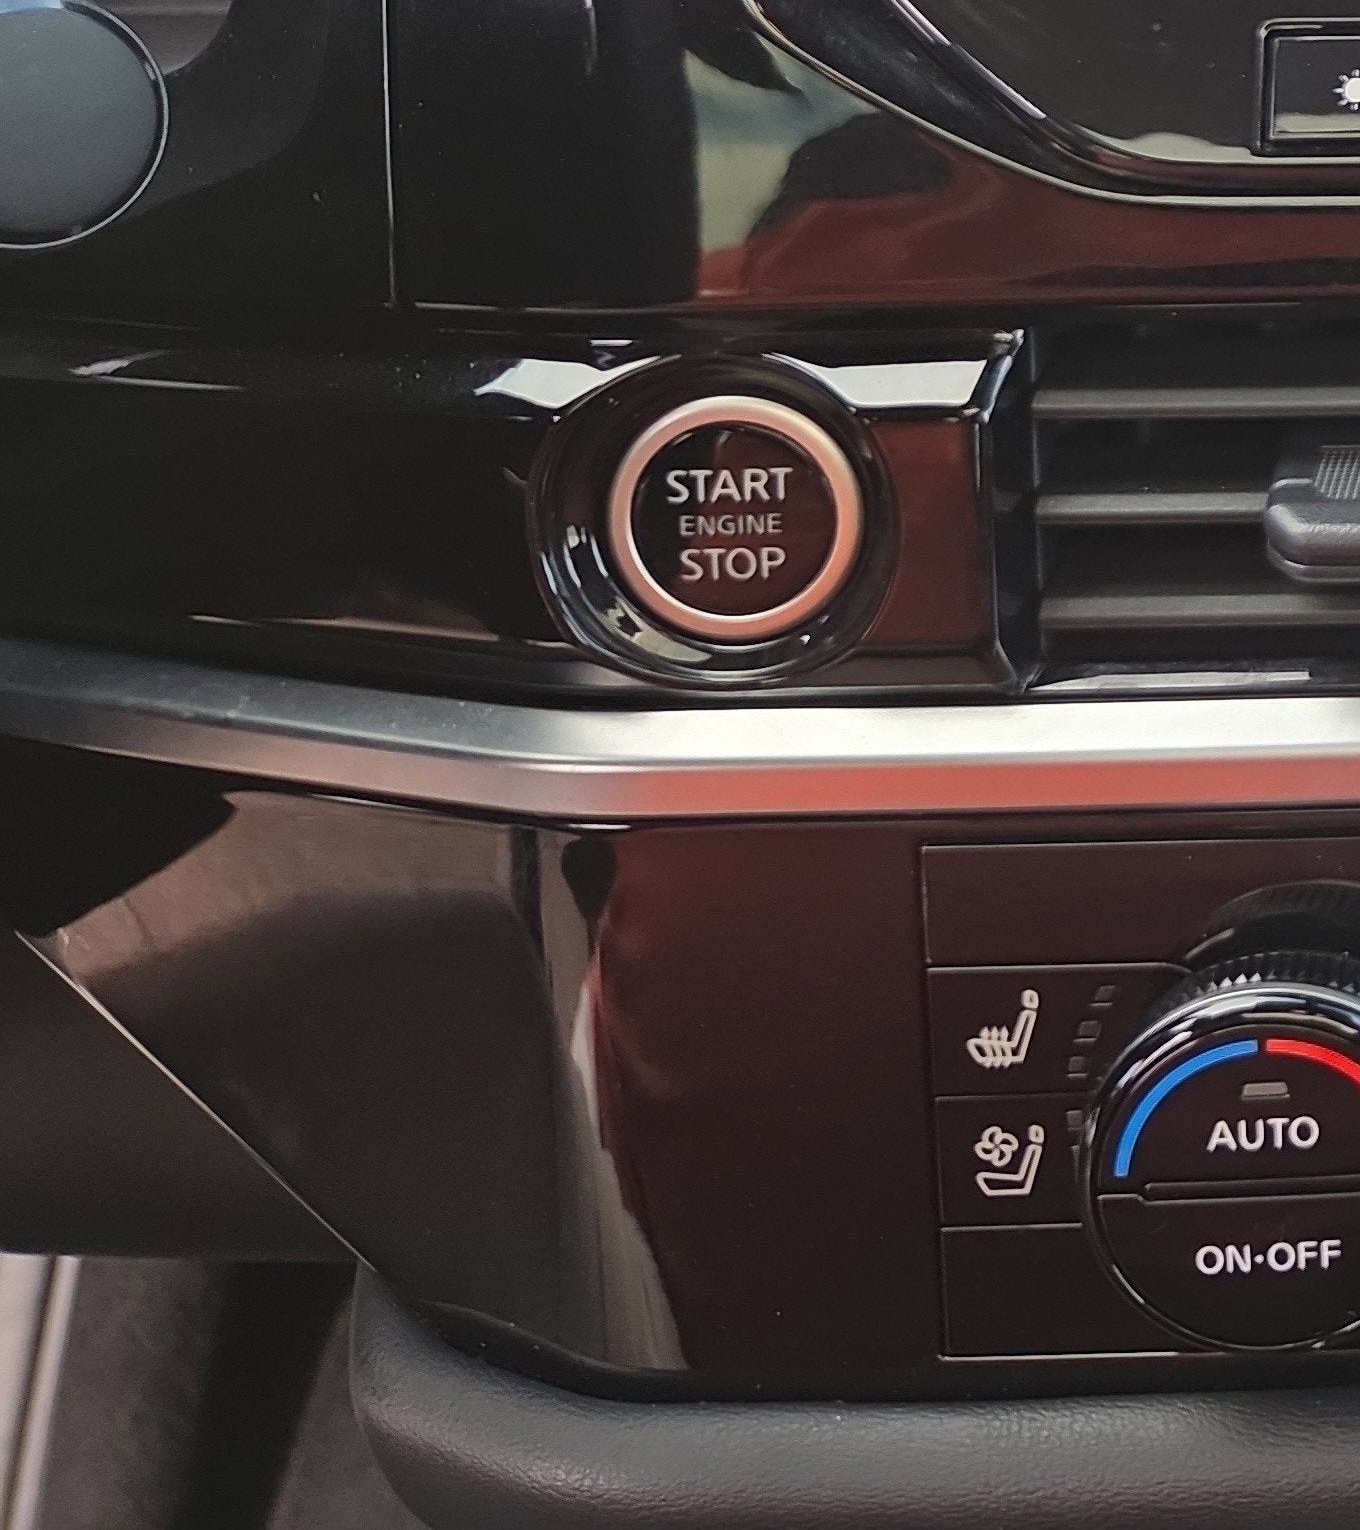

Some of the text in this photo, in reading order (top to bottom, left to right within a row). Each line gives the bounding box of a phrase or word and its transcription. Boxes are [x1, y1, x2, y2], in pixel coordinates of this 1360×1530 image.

[665, 467, 795, 504] START
[678, 512, 784, 538] ENGINE
[679, 546, 787, 581] STOP
[1205, 1115, 1321, 1153] AUTO
